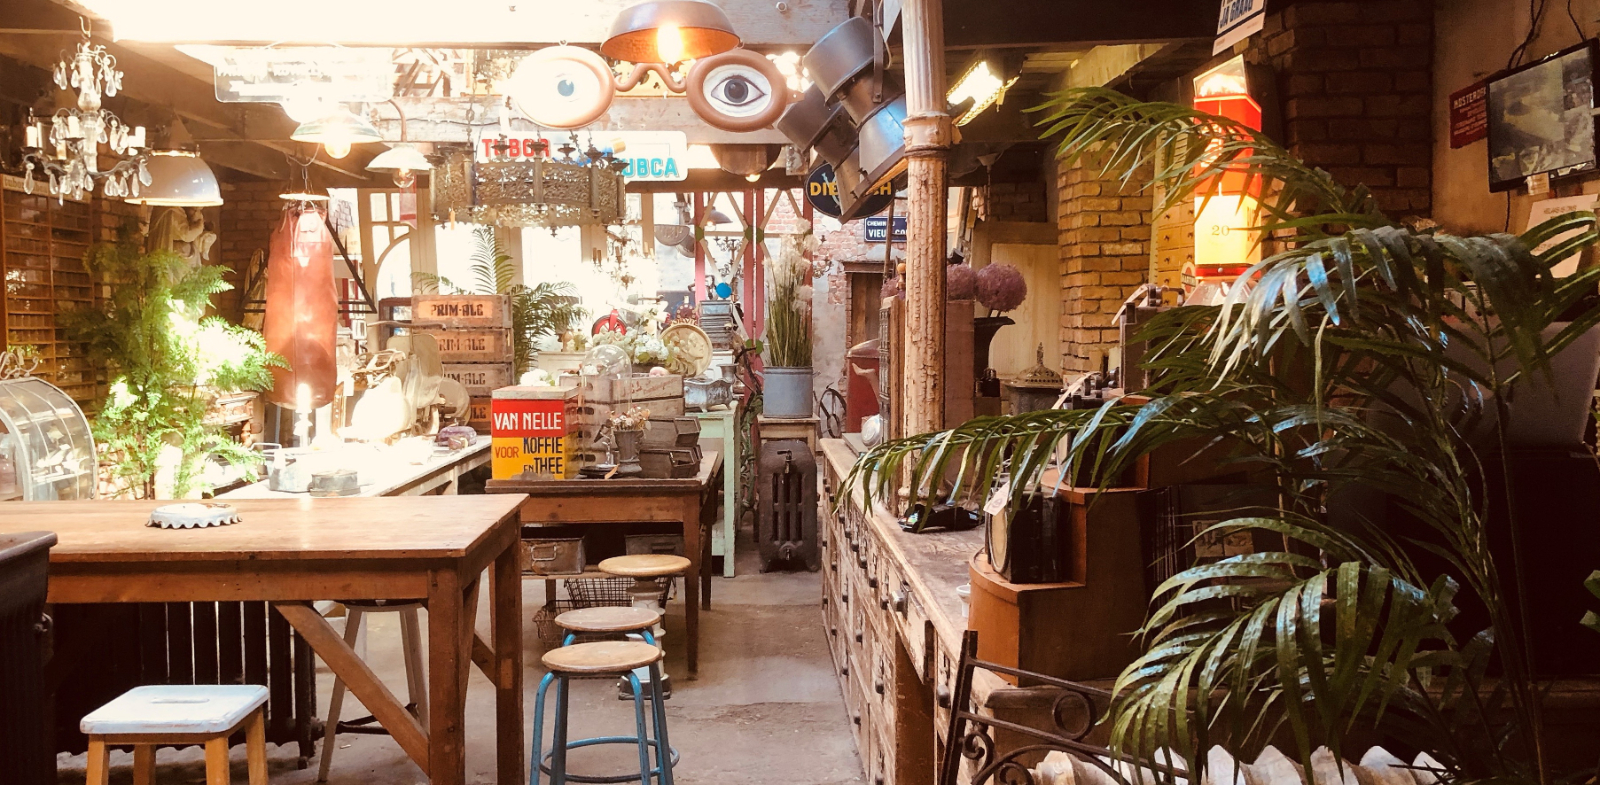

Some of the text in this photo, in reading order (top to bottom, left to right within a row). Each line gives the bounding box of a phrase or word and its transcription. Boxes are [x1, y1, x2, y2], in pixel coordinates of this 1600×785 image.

[612, 158, 678, 176] UBCA
[868, 228, 889, 238] VIEU
[1211, 225, 1230, 236] 20
[493, 412, 519, 430] VAN
[522, 412, 562, 430] NELLE
[494, 446, 520, 459] VOOR
[523, 436, 563, 454] KOFFIE
[533, 457, 563, 474] THEE
